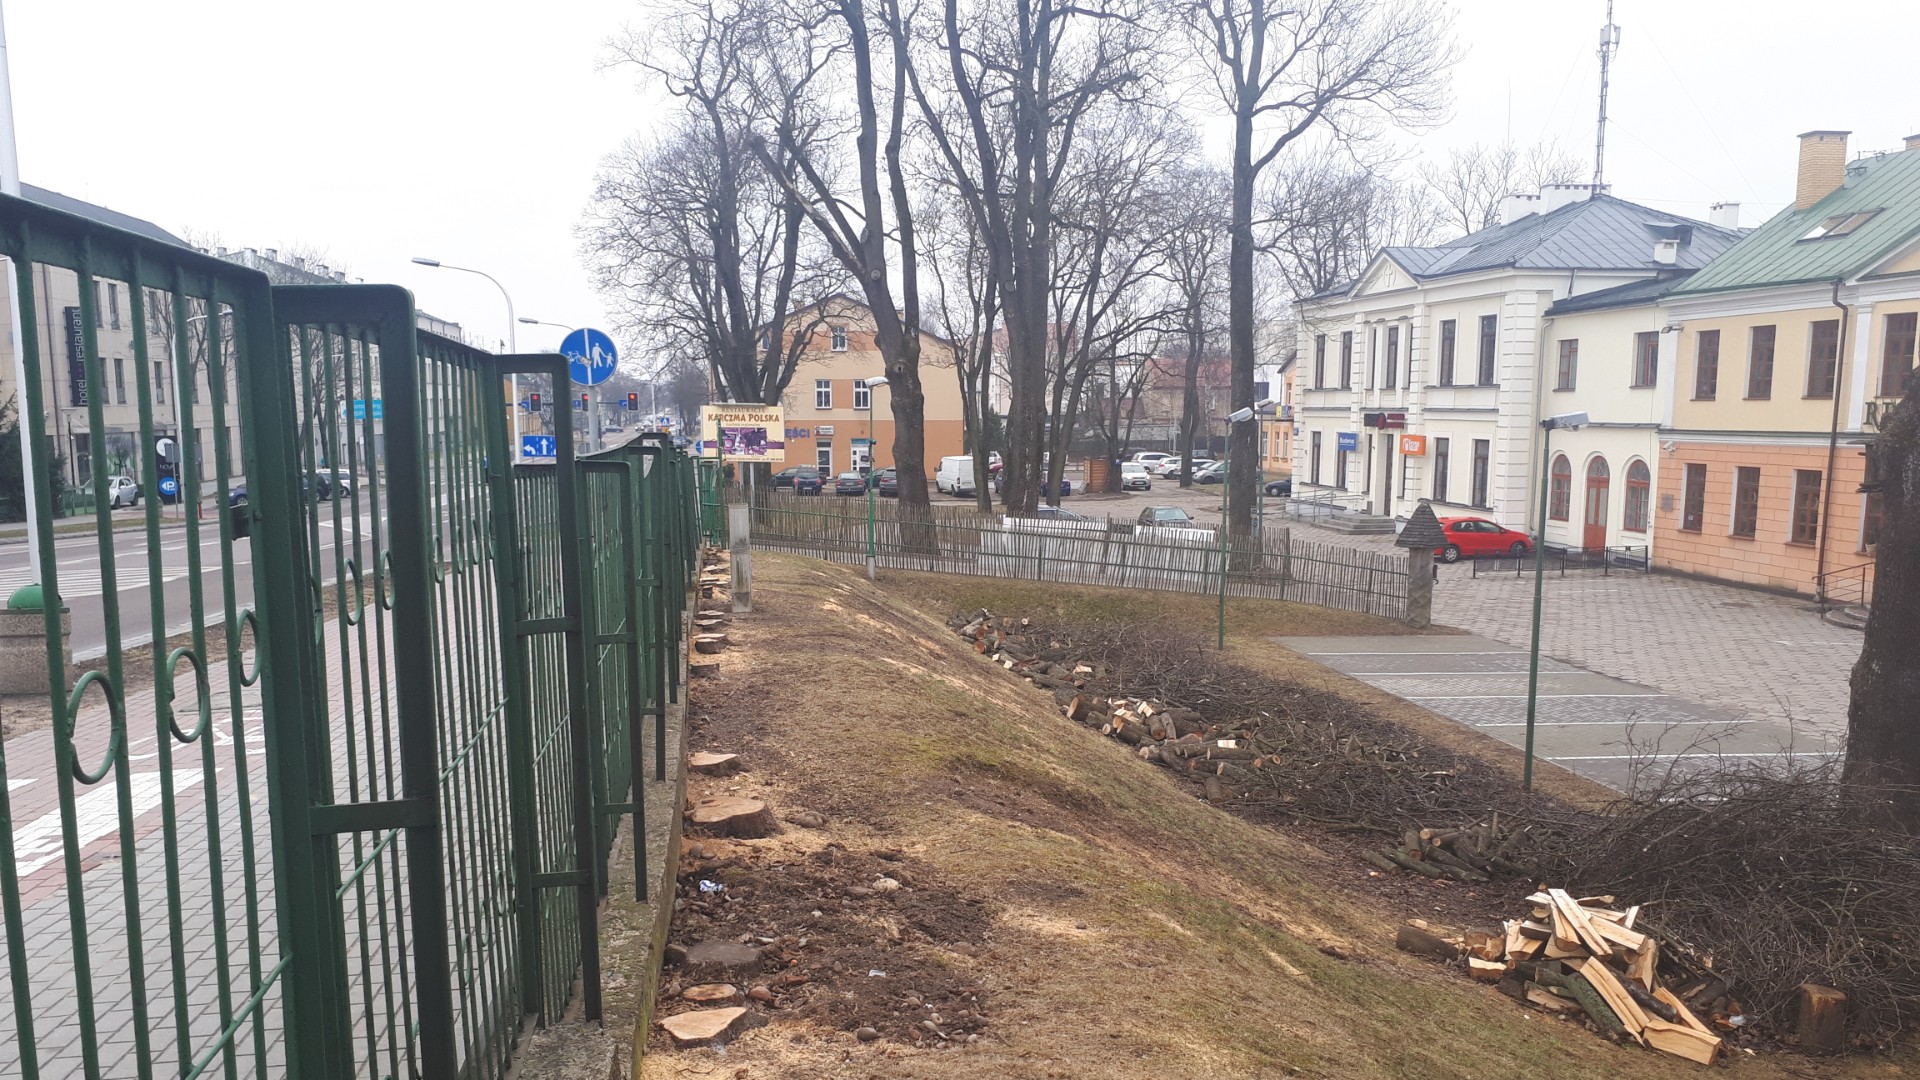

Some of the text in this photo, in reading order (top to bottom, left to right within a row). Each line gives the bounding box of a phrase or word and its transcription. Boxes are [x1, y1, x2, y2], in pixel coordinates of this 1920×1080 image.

[72, 308, 88, 405] hotel restaurant
[708, 413, 780, 423] KARCZMA POLSKA
